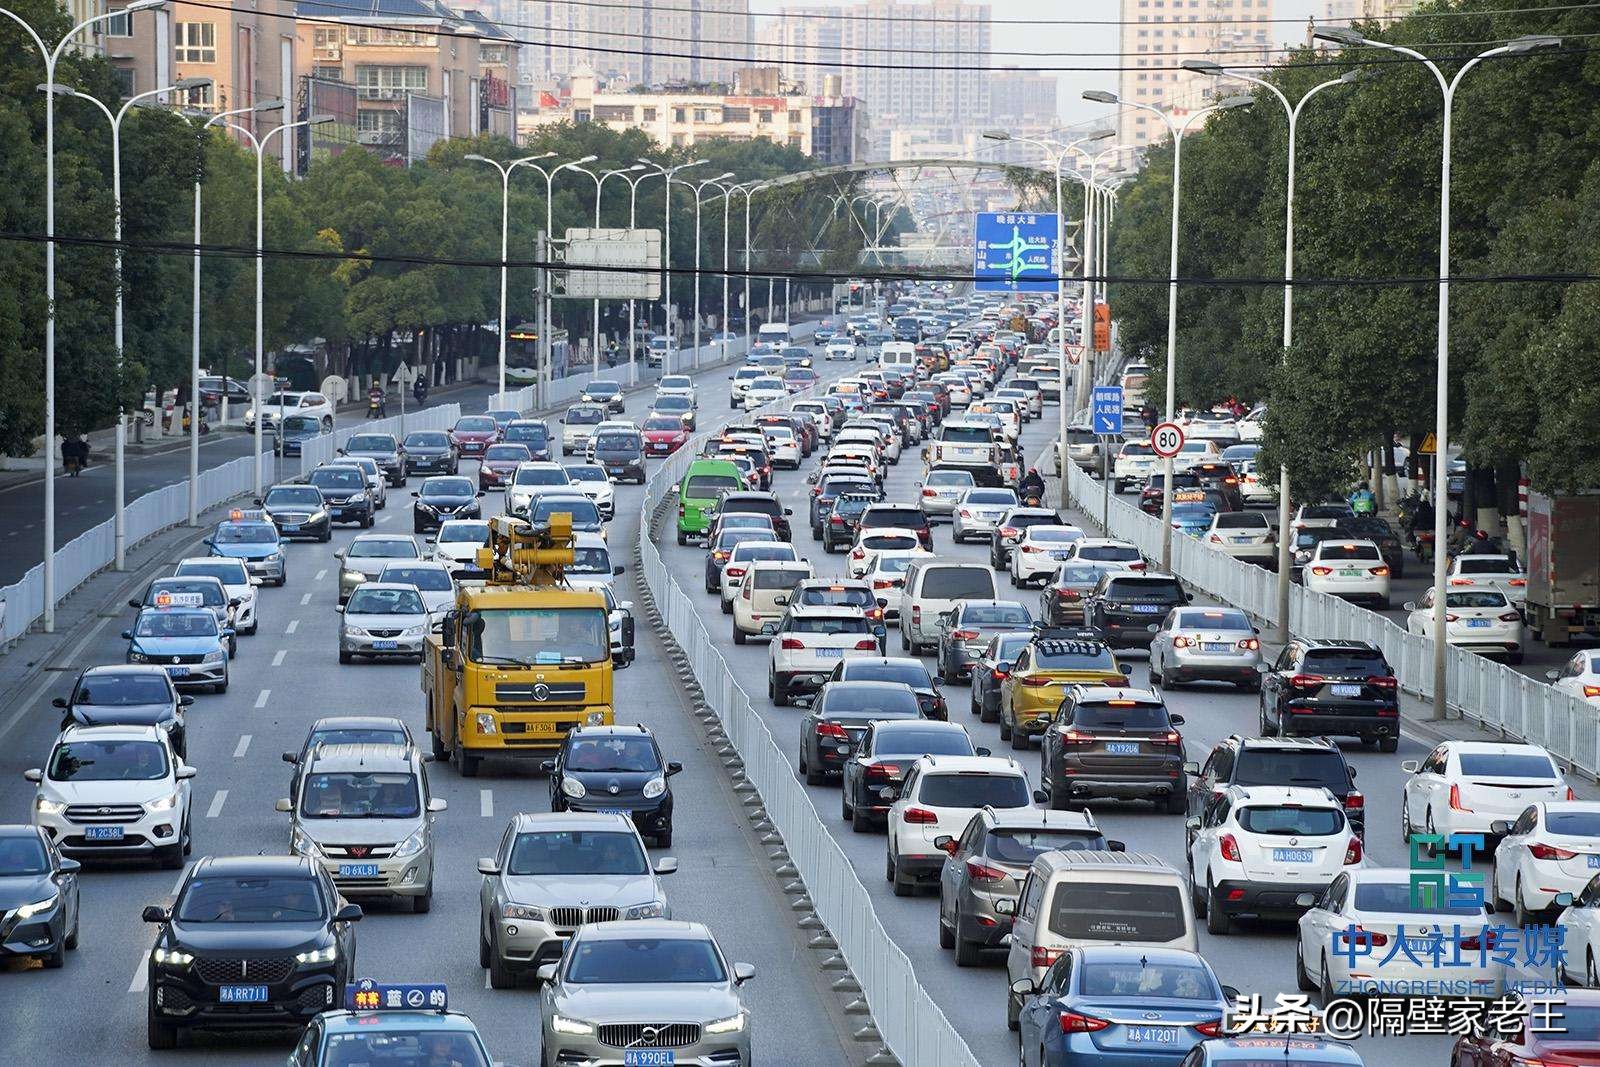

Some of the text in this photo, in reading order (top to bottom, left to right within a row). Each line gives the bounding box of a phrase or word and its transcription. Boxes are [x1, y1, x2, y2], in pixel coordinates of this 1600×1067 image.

[1095, 404, 1120, 414] 人民路
[1159, 432, 1177, 447] 80
[355, 990, 380, 1006] 有客
